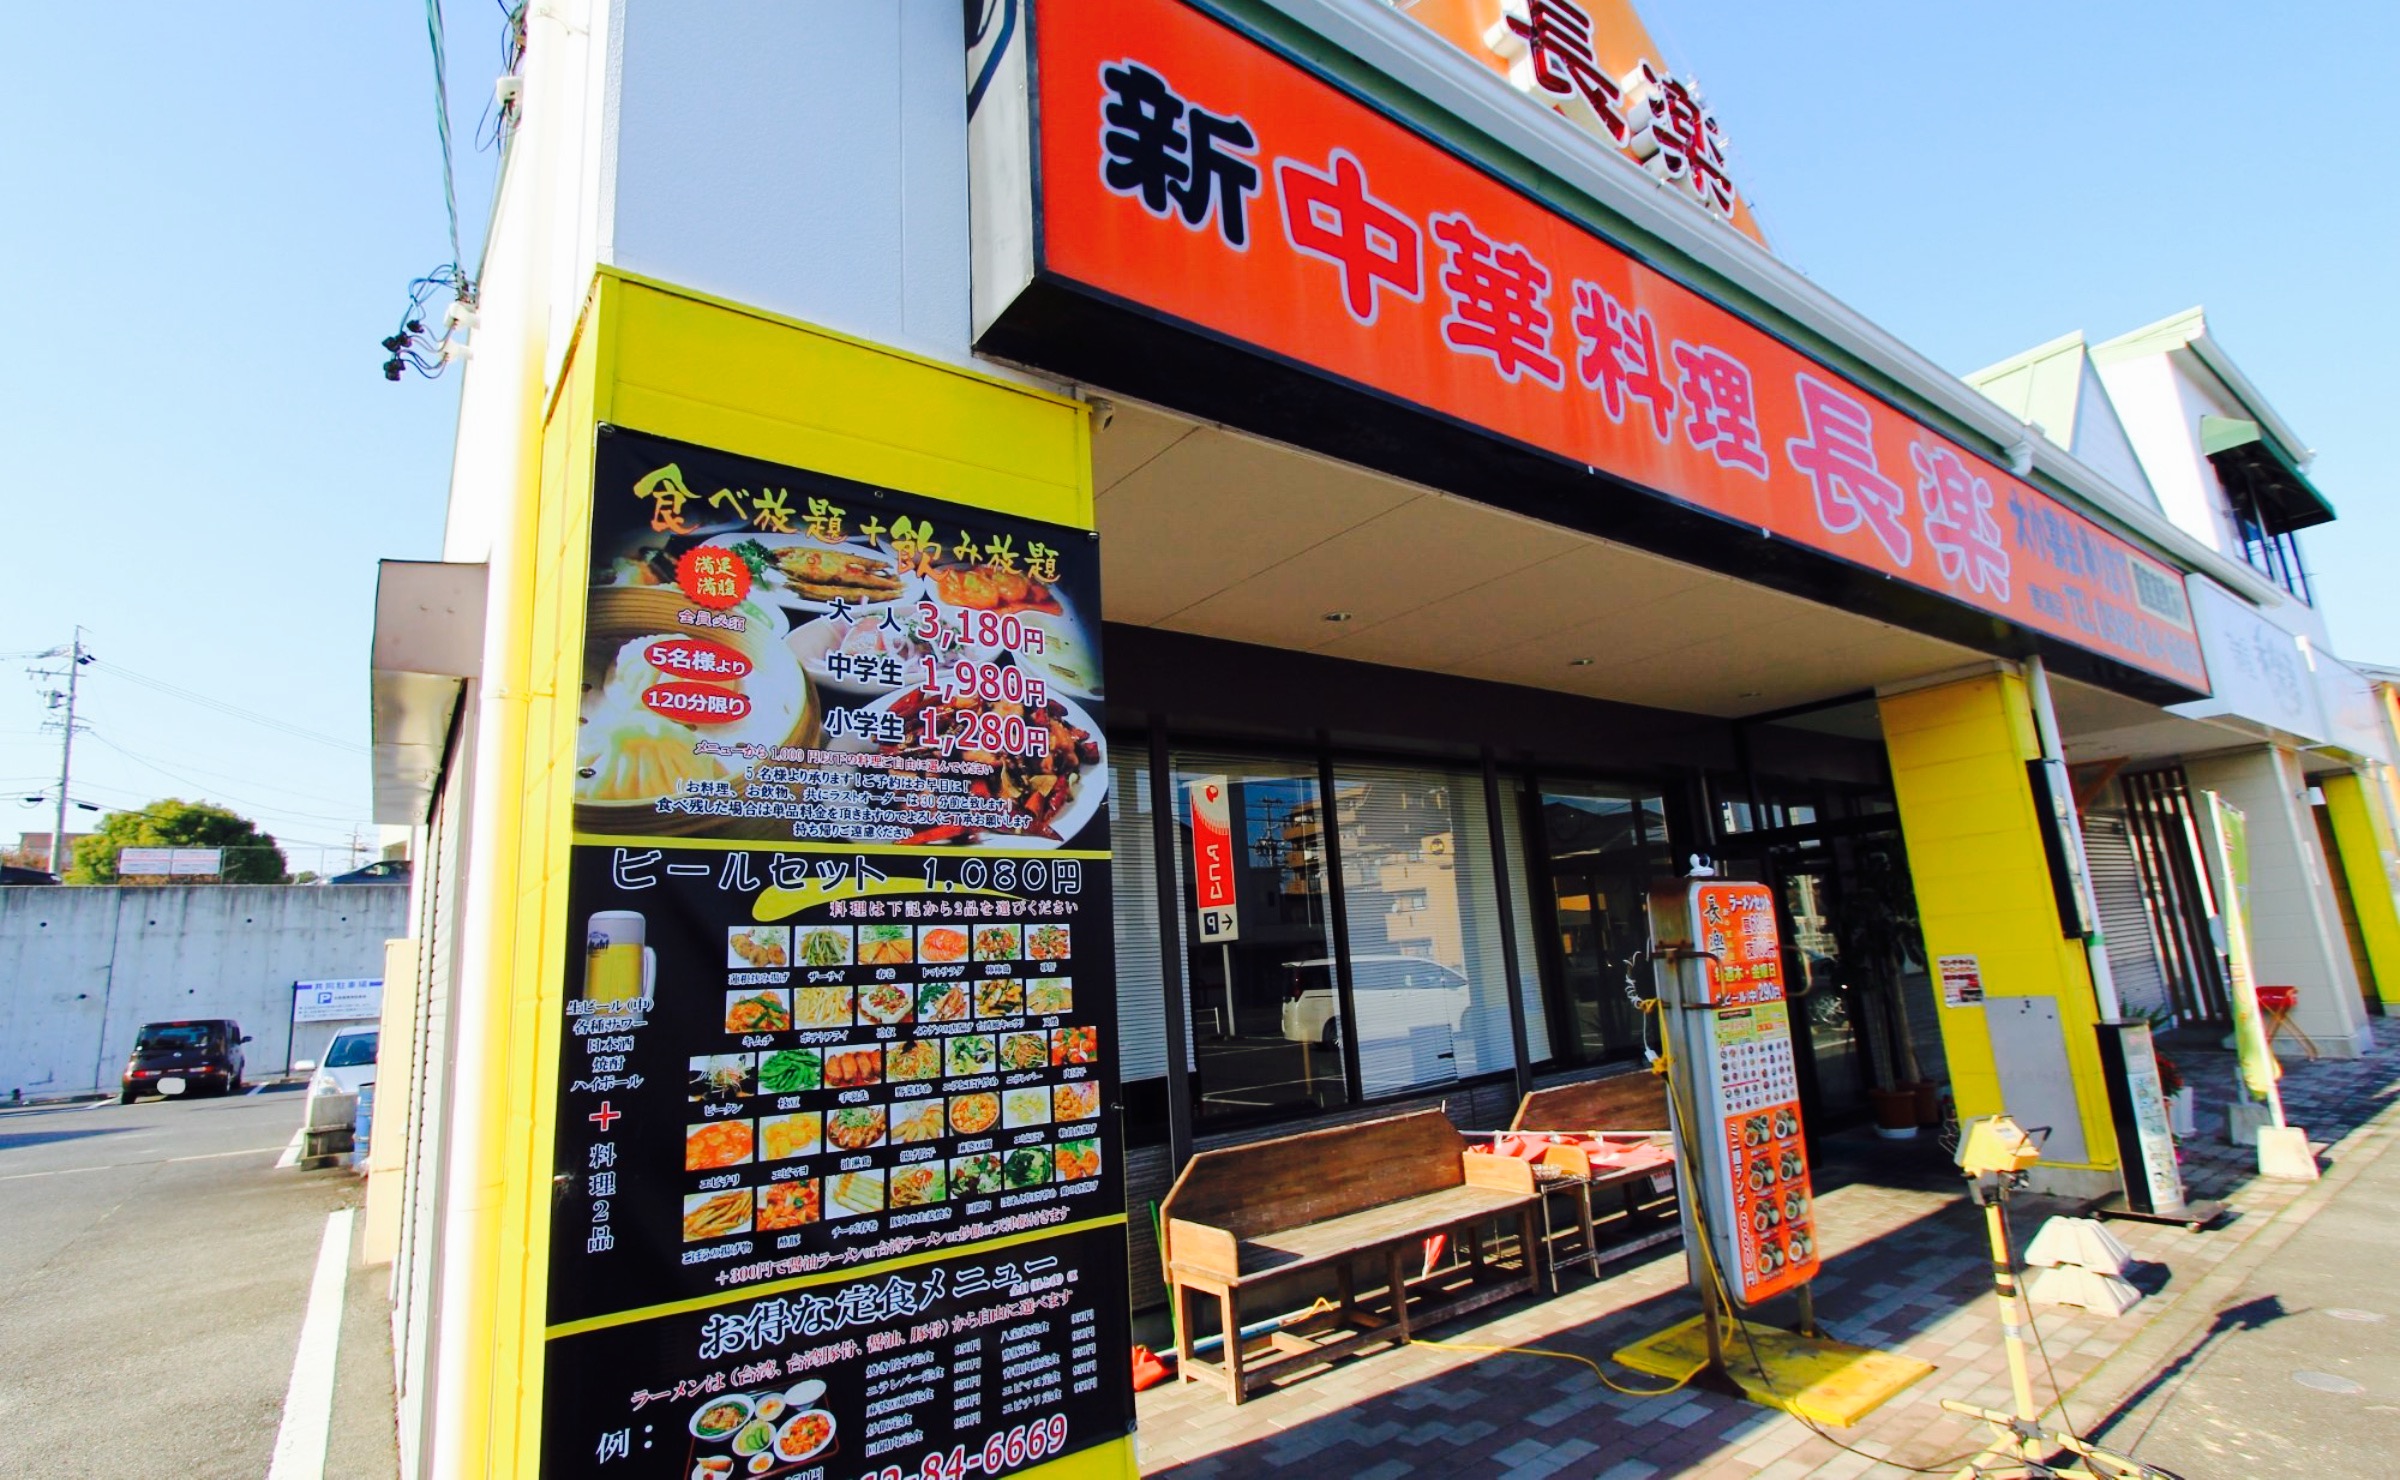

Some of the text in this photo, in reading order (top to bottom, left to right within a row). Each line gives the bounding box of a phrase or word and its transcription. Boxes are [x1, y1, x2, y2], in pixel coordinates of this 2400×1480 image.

[1505, 0, 1736, 219] 長楽
[694, 556, 738, 579] 満足
[695, 576, 740, 599] 満腹
[678, 609, 746, 632] 全員必須
[915, 601, 1046, 657] 3,180円
[649, 646, 749, 678] 5名様より
[826, 650, 1049, 708] 中学生 1,980円
[647, 689, 748, 718] 120分限り
[825, 704, 1051, 759] 小学生 1,280円
[613, 847, 1081, 894] ビールセット 1,080円
[566, 996, 654, 1016] 生ビール(中)
[573, 1018, 648, 1035] 各種サワー
[587, 1035, 635, 1053] 日本酒
[742, 1034, 774, 1047] キムチ
[591, 1055, 625, 1072] 焼酎
[570, 1074, 644, 1092] ハイボール
[699, 1174, 740, 1189] エビチリ
[587, 1142, 617, 1253] 料理2品
[699, 1256, 1058, 1359] お得な定食メニュー
[858, 1413, 1068, 1480] -84-6669
